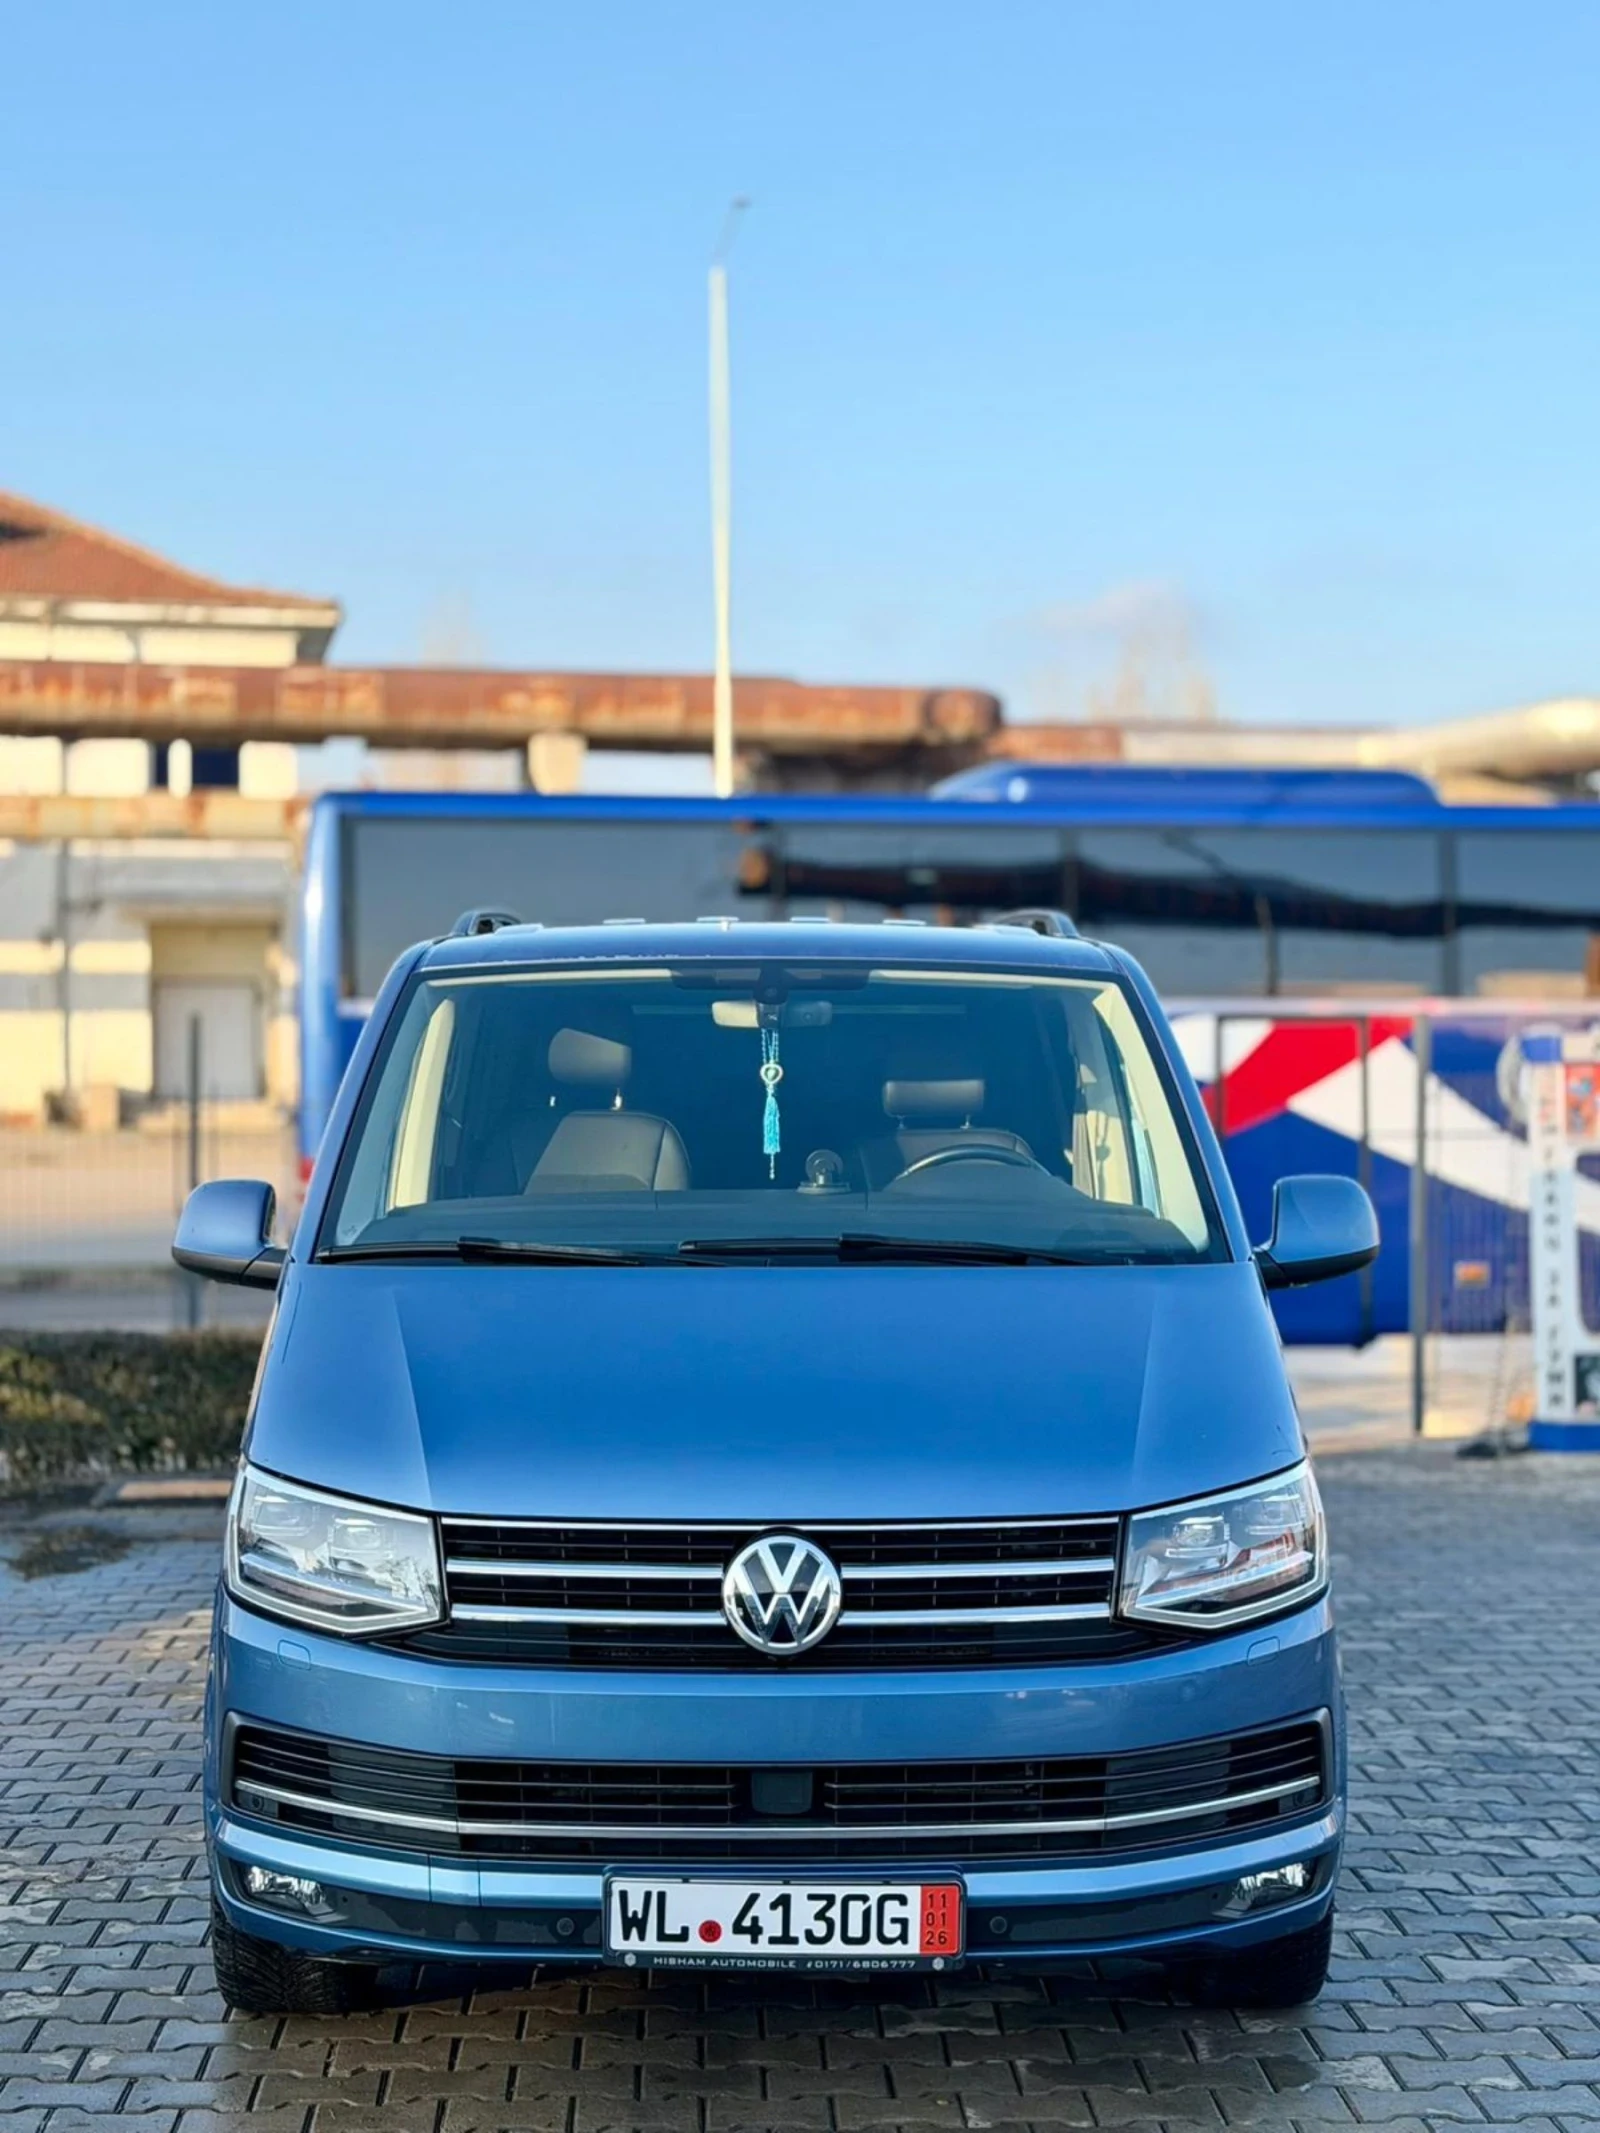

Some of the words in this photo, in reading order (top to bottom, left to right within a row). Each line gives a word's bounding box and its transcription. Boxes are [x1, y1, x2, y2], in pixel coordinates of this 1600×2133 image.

[723, 1534, 841, 1655] VW
[928, 1893, 946, 1908] 11
[618, 1890, 689, 1943] WL
[926, 1911, 946, 1927] 01
[925, 1930, 947, 1945] 26
[710, 1958, 797, 1968] AUTOMOBILE
